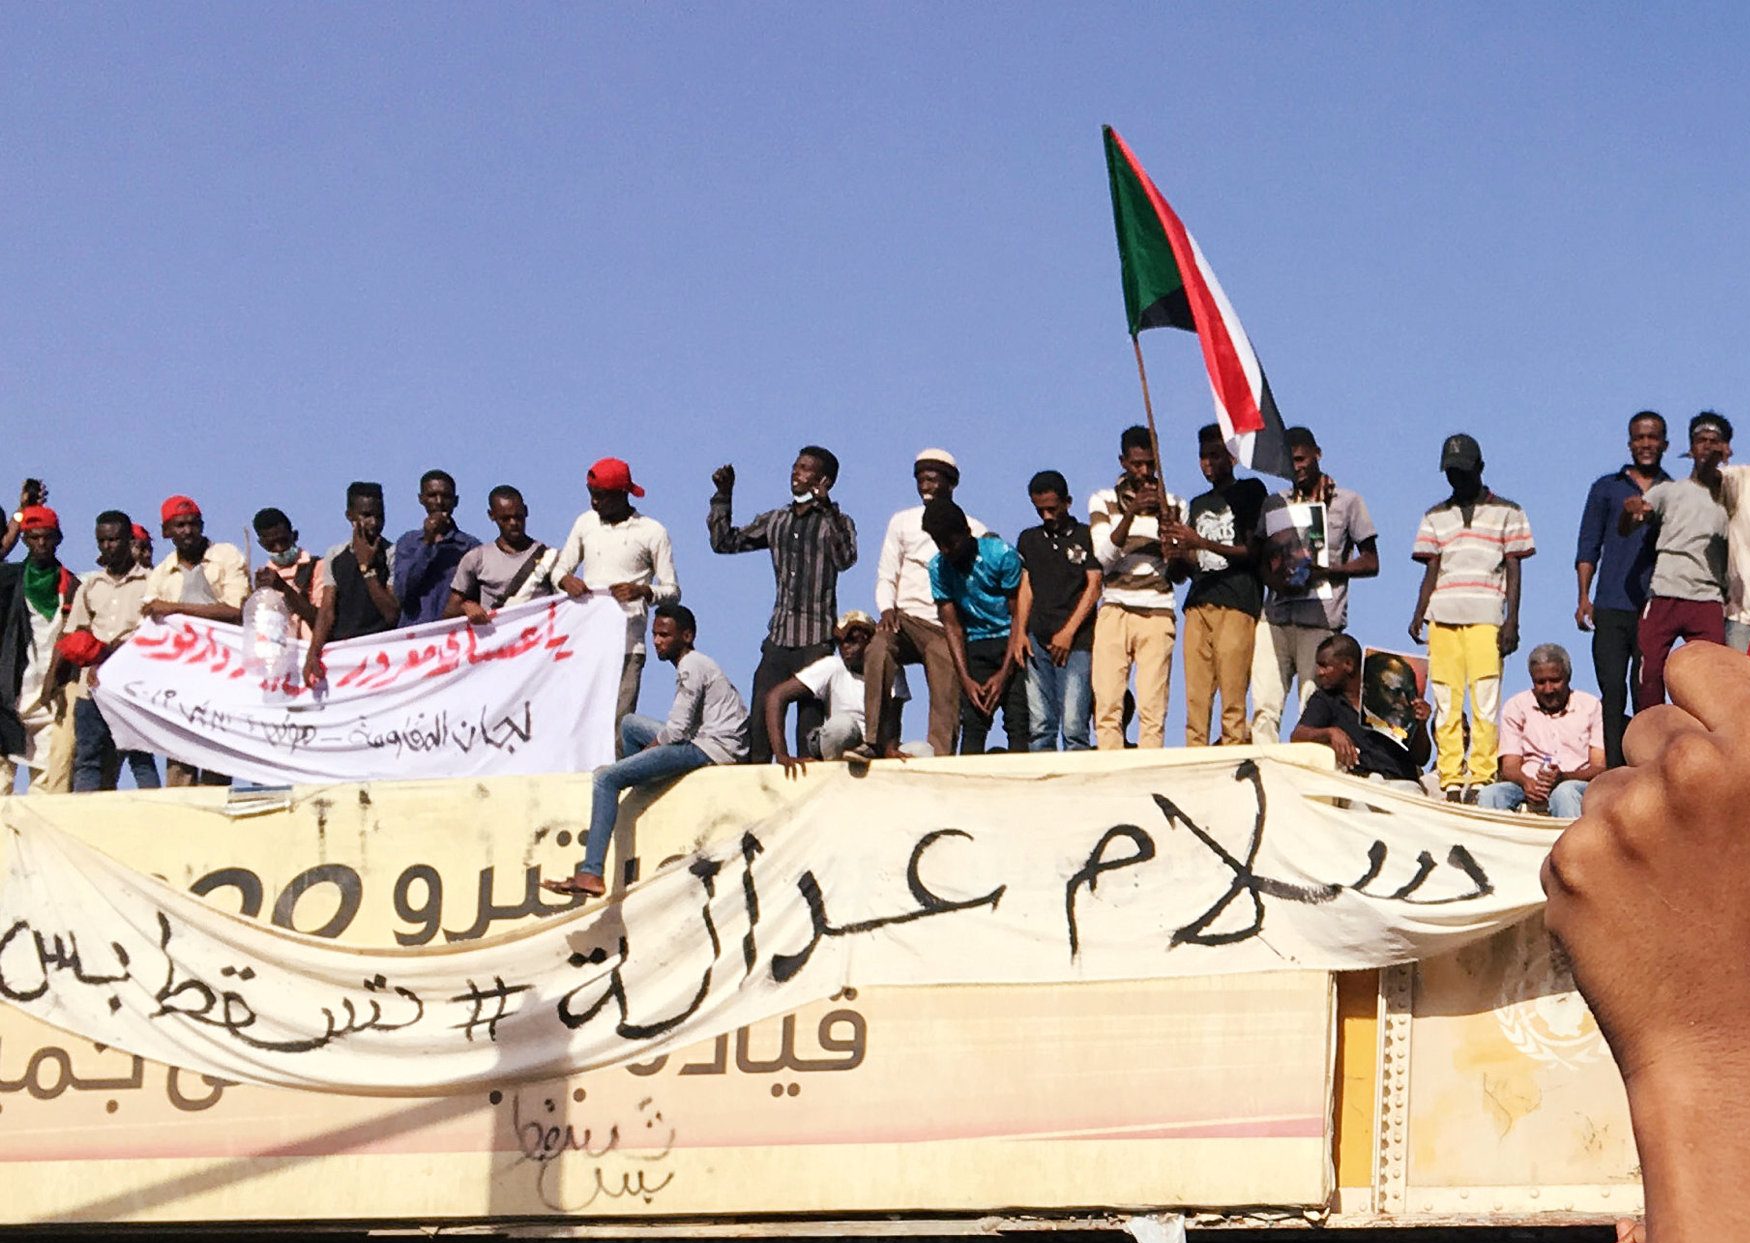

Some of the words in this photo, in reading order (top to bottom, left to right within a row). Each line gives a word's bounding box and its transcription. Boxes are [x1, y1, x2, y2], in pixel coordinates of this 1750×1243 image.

[452, 700, 531, 754] لجان
[1067, 759, 1495, 960] سلام
[0, 920, 131, 1013] بس
[558, 828, 1007, 1039] عدالة
